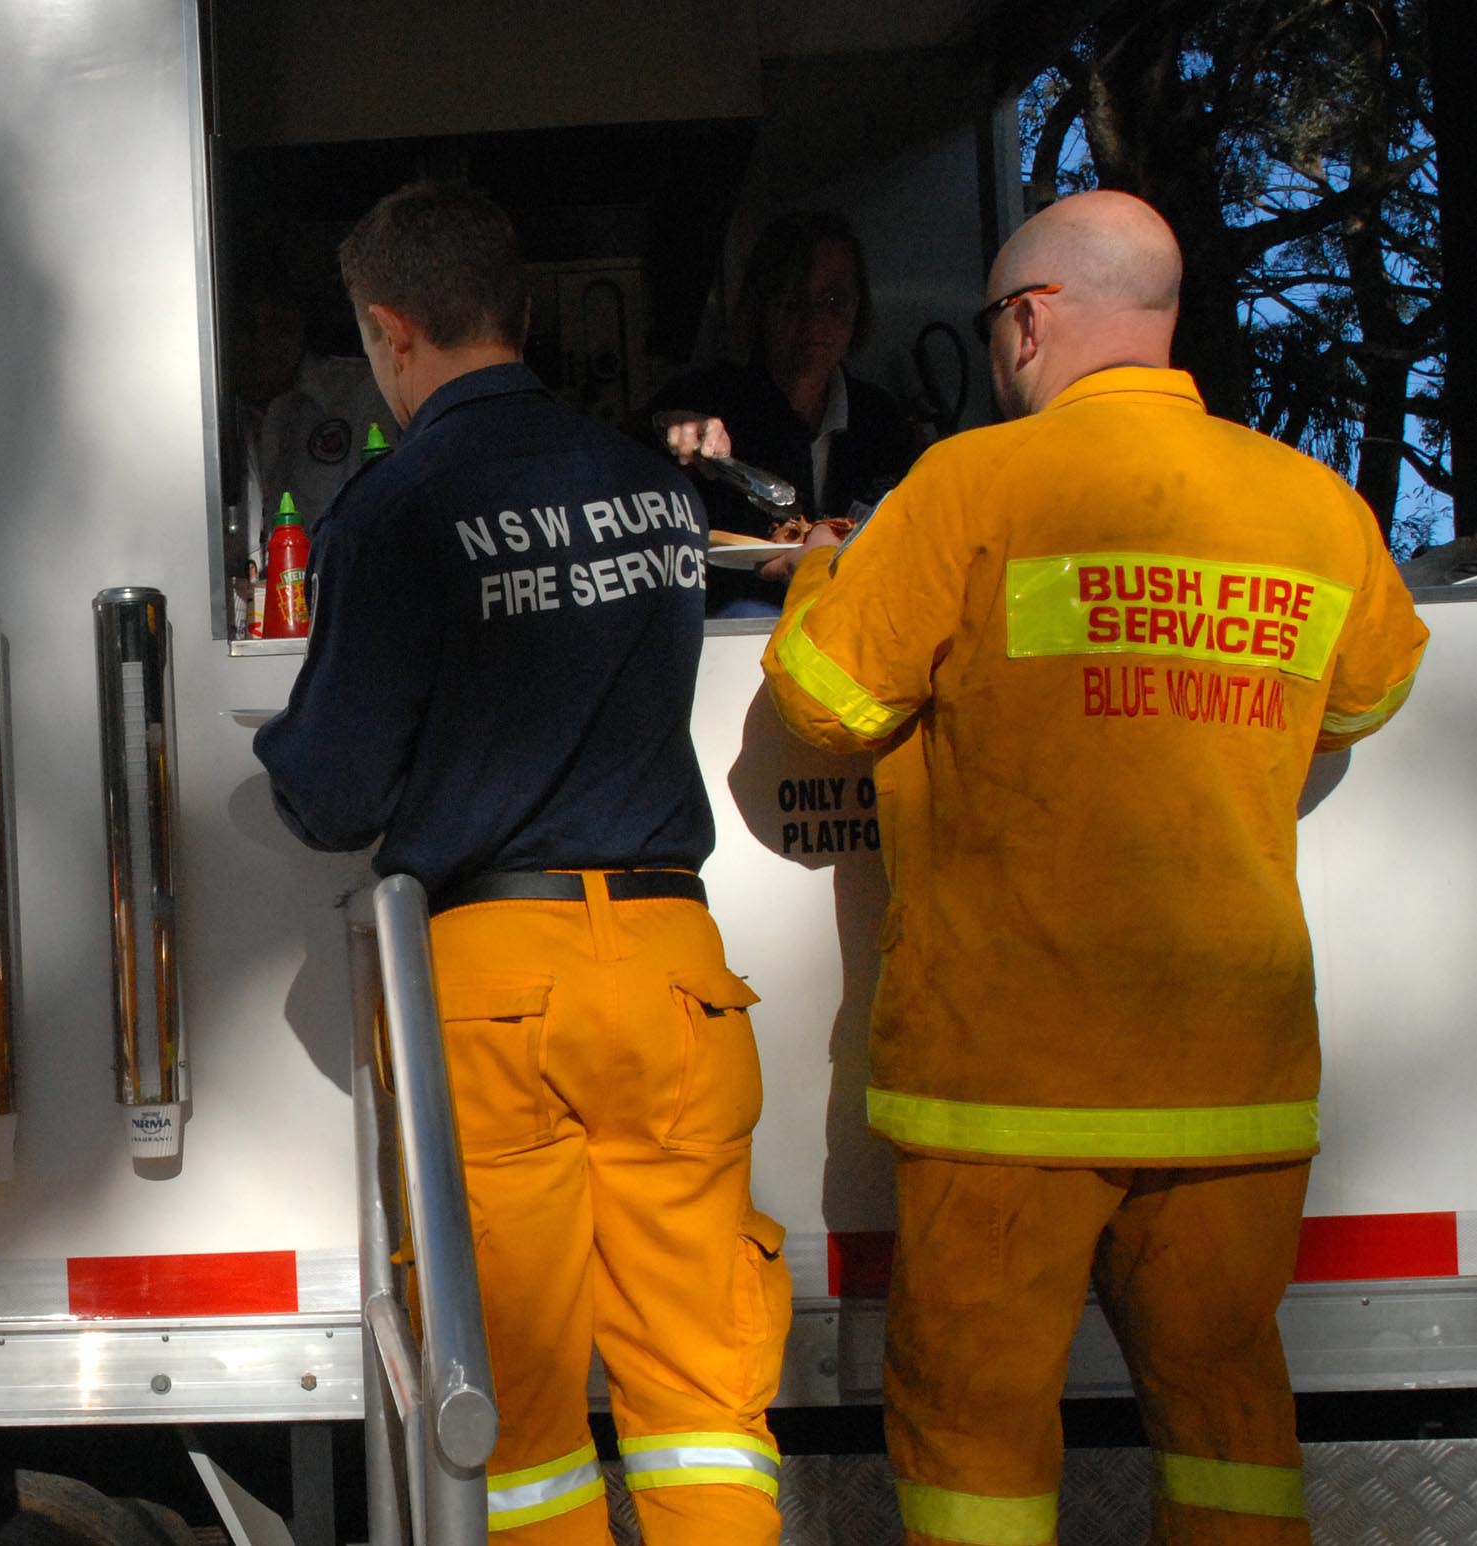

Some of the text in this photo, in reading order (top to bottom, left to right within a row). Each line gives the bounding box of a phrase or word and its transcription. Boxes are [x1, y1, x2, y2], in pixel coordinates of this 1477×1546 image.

[455, 491, 700, 561] NSW RURAL
[480, 545, 706, 620] FIRE SERVICE
[1077, 565, 1315, 621] BUSH FIRE
[1087, 606, 1299, 660] SERVICES
[1083, 667, 1287, 731] BLUE MOUNTAIN
[778, 777, 846, 812] ONLY
[131, 1118, 172, 1129] NRMA
